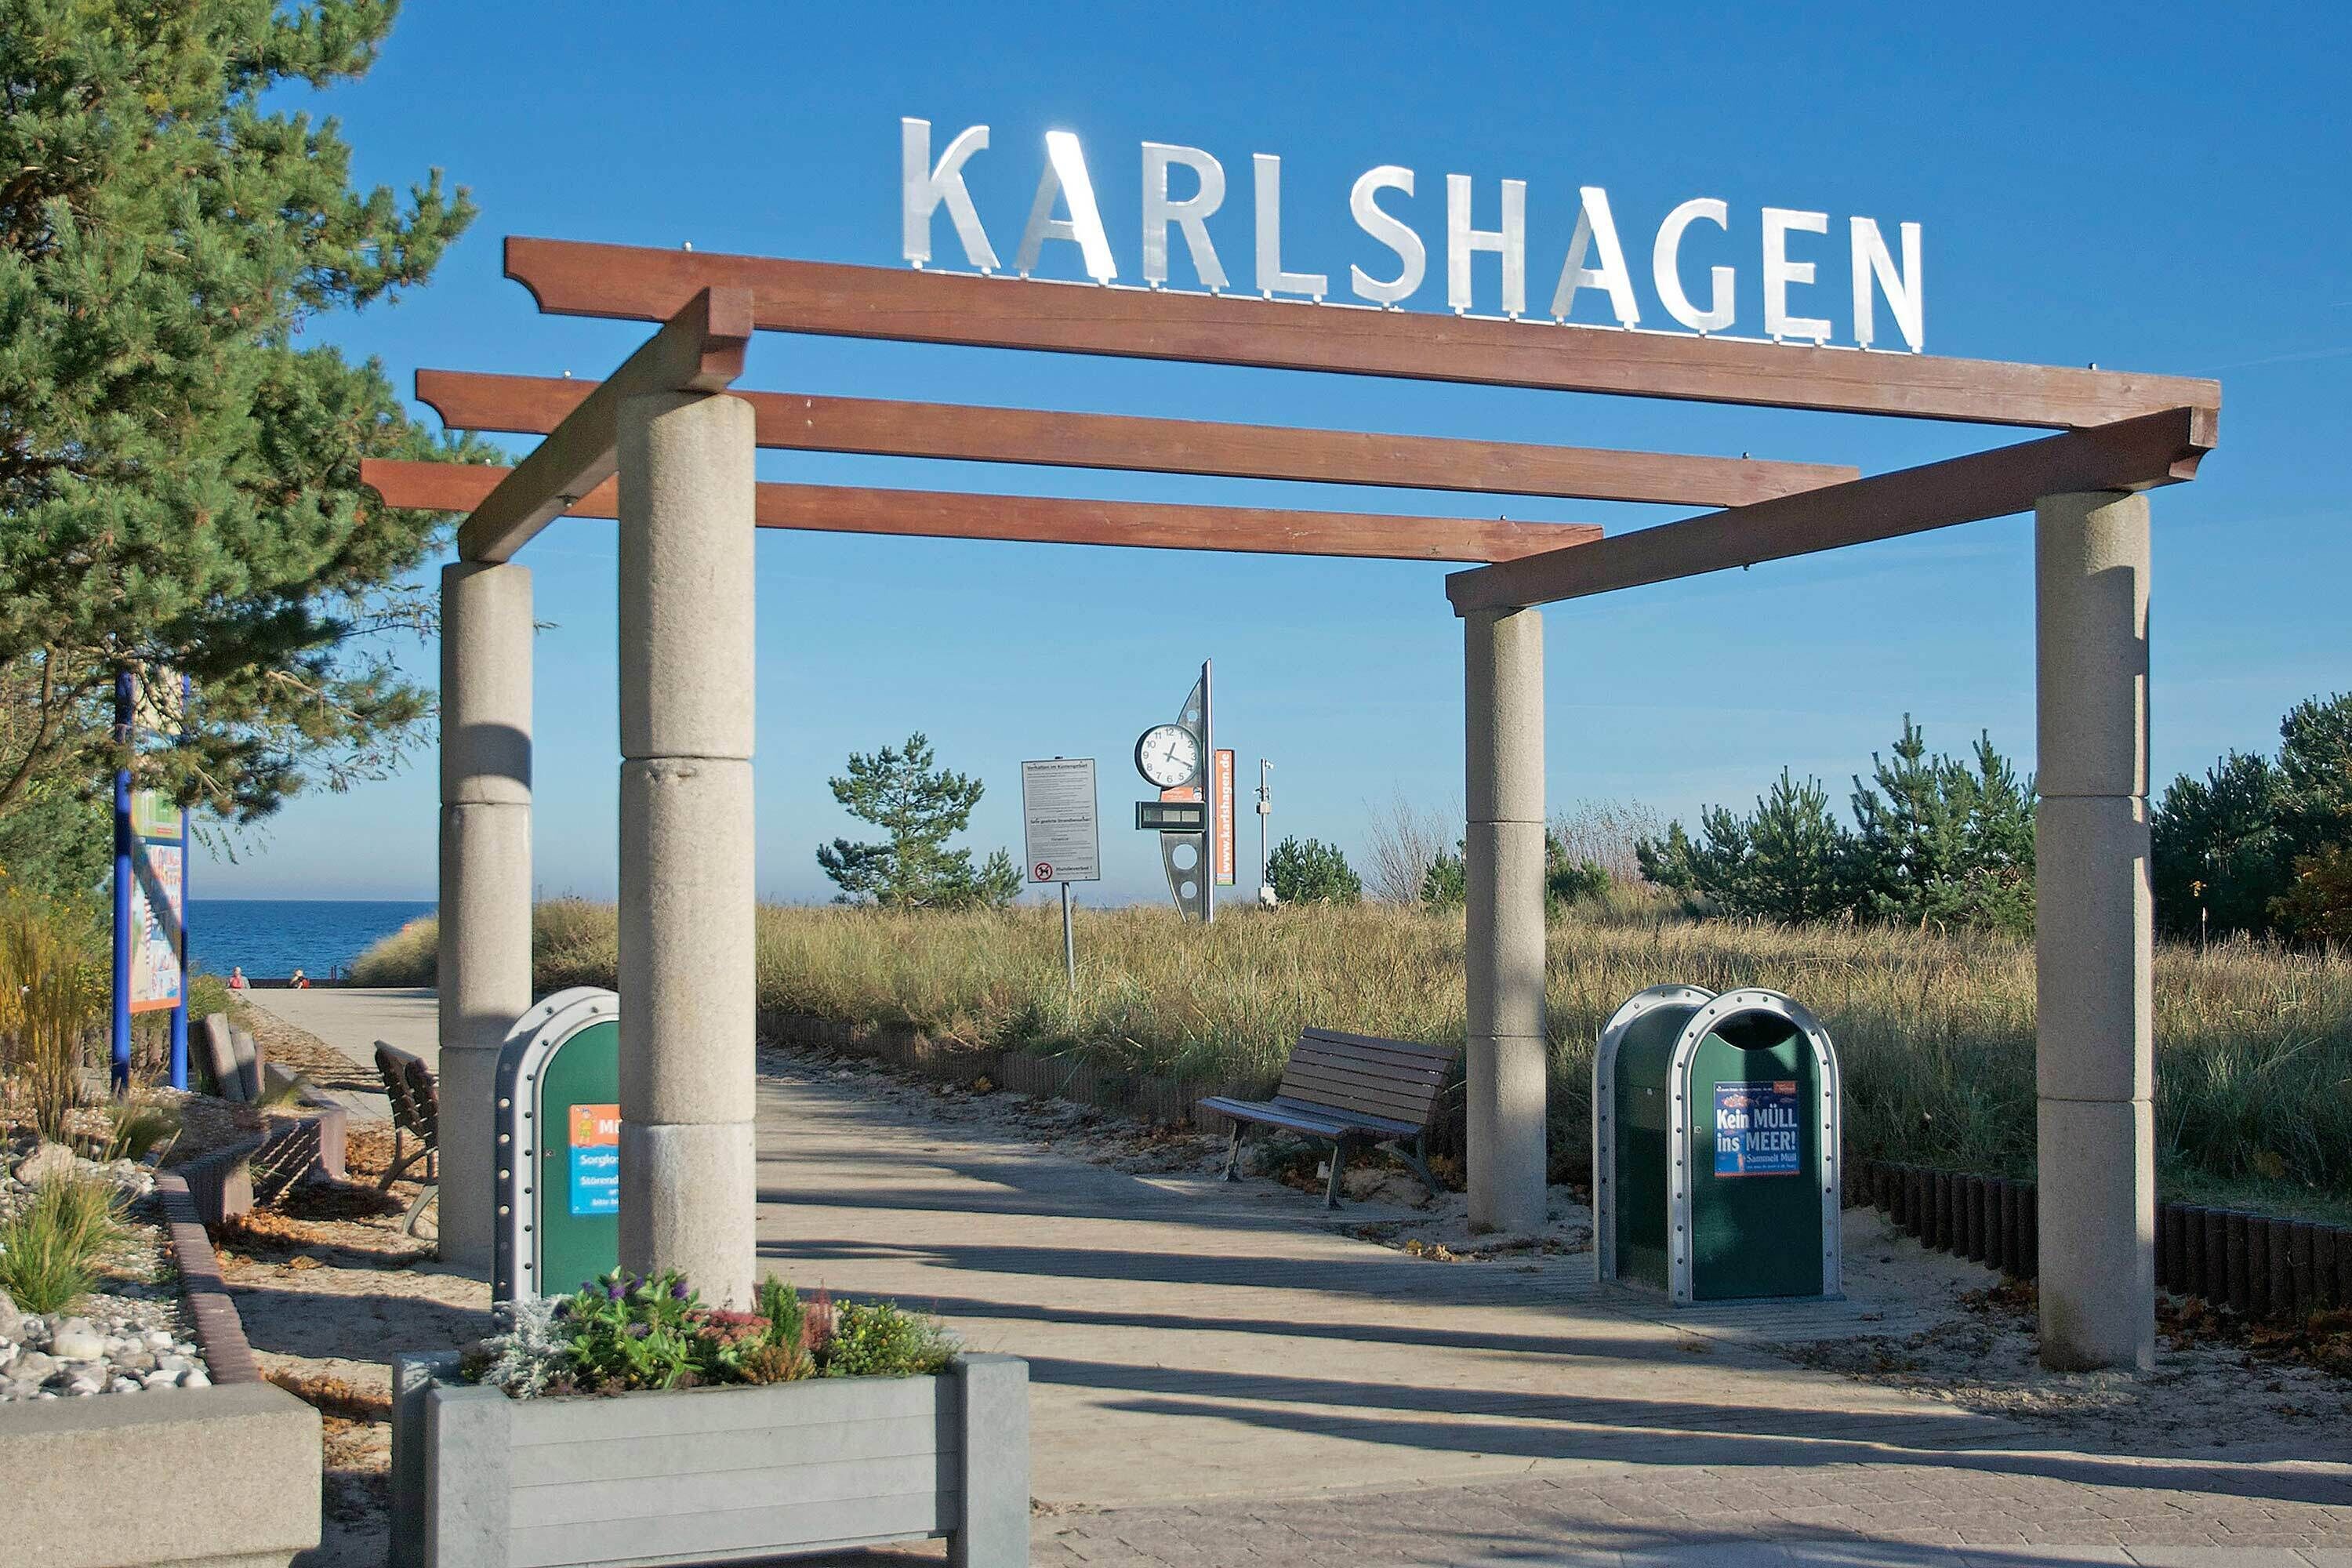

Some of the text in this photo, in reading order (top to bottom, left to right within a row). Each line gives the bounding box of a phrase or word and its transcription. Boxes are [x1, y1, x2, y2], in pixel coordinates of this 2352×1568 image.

[902, 118, 1923, 350] KARLSHAGEN
[1165, 728, 1174, 736] 12
[1146, 740, 1156, 749] 10
[1187, 740, 1194, 749] 2
[1142, 751, 1149, 760] 9
[1146, 763, 1152, 771] 8
[1167, 775, 1174, 783] 6
[1178, 772, 1185, 781] 5
[1220, 753, 1232, 872] www.karlshagen.de
[1716, 1103, 1797, 1130] Kein MÜLL
[1717, 1131, 1796, 1152] ins MEER!
